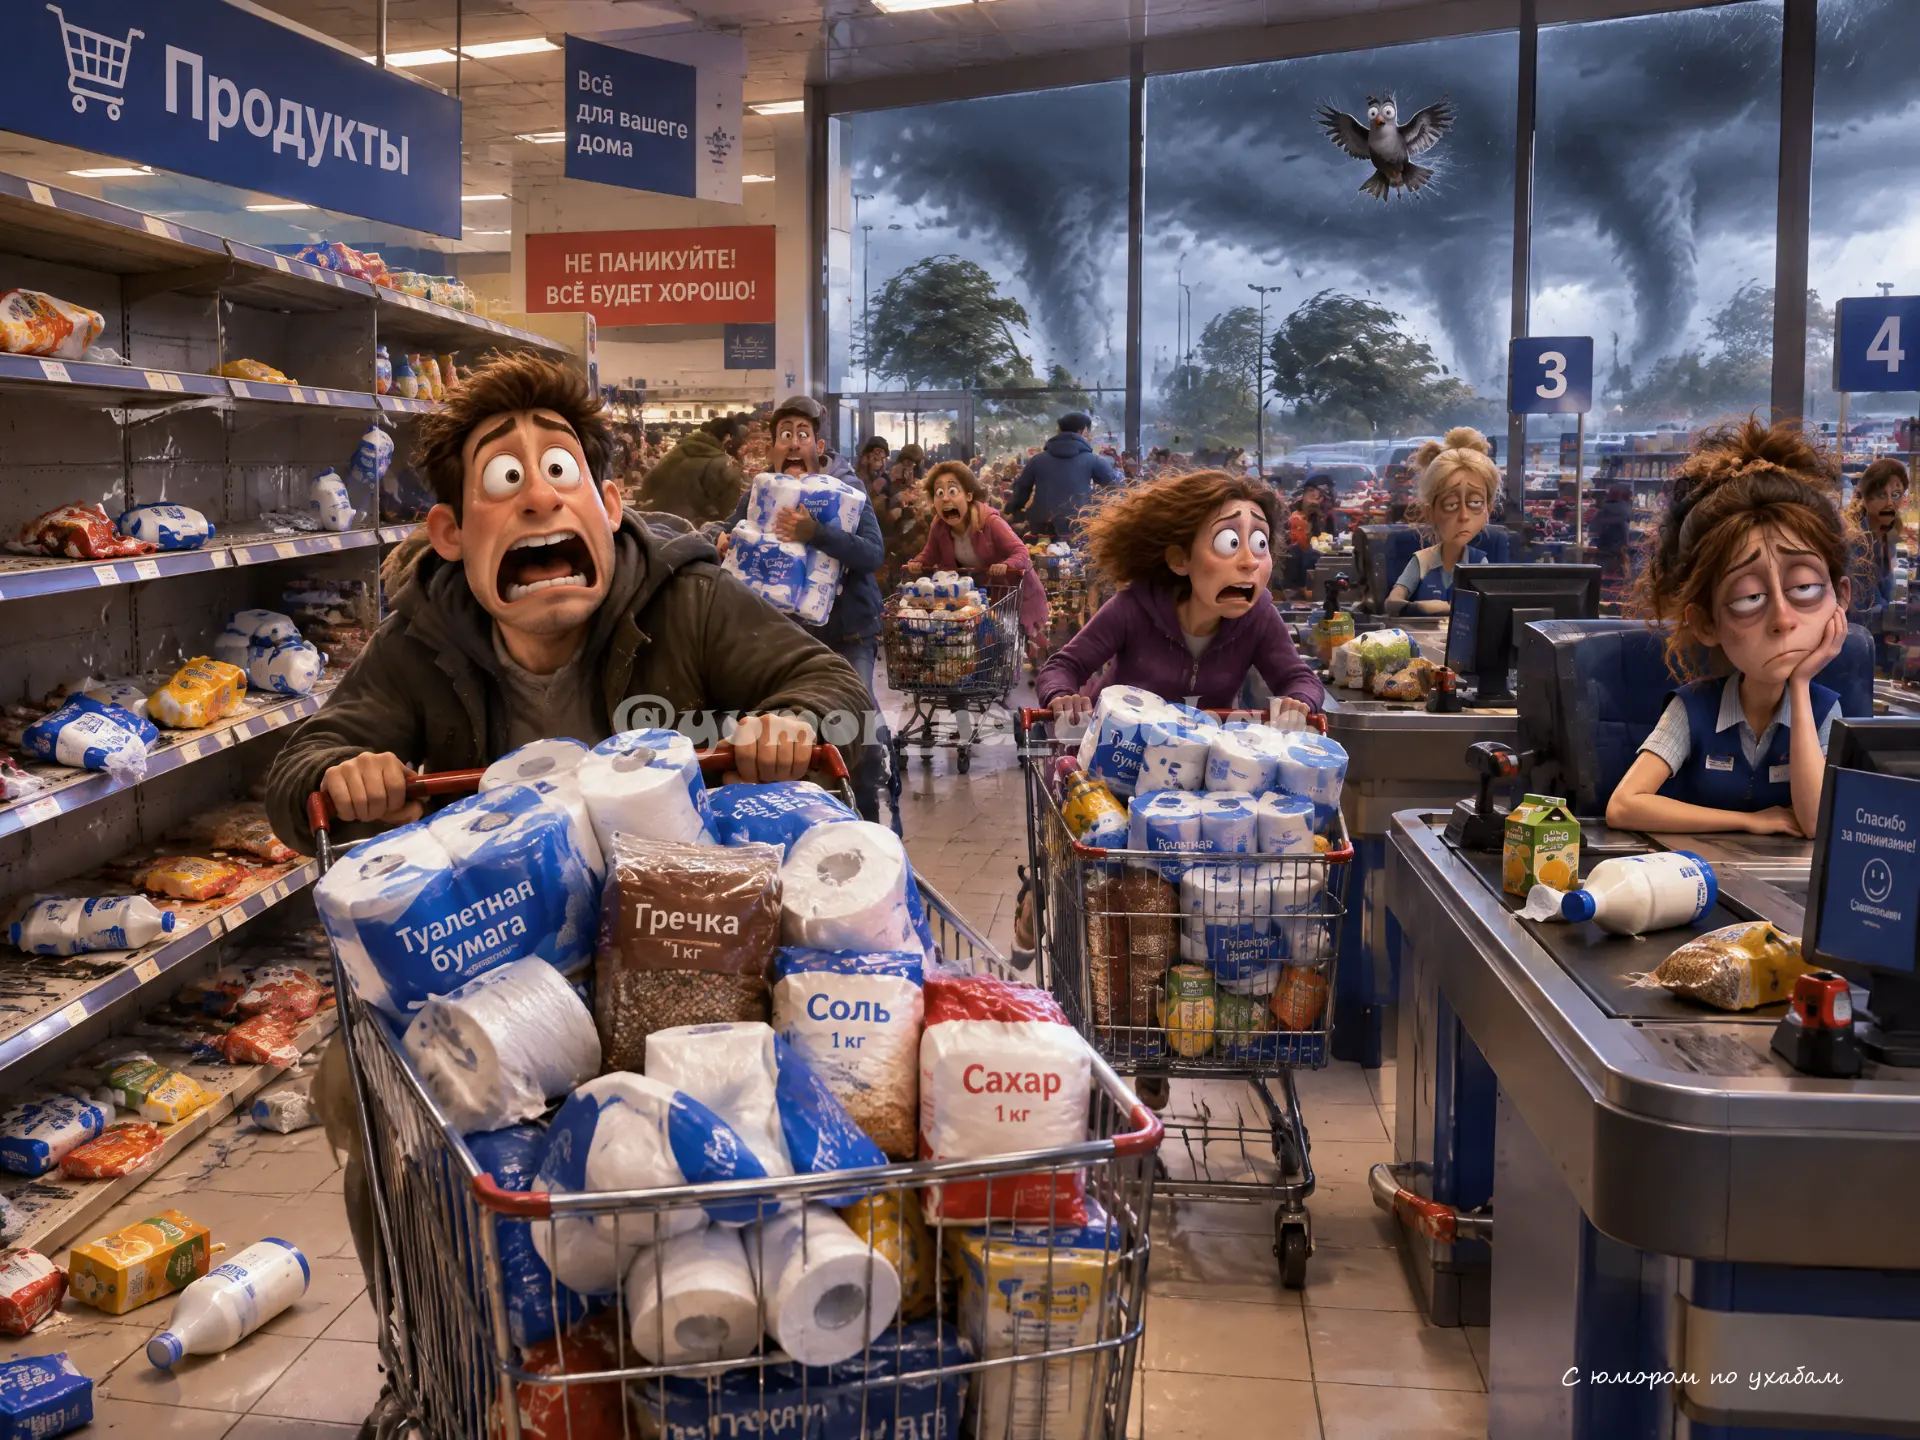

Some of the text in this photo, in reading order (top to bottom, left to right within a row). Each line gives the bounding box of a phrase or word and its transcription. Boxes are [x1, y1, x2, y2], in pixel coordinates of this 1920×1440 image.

[578, 70, 613, 97] Всё
[165, 44, 409, 176] Продукты
[576, 103, 614, 125] для
[577, 133, 633, 158] дома
[565, 245, 736, 273] НЕ ПАНИКУЙТЕ!
[546, 280, 756, 307] ВСЁ БУДЕТ ХОРОШО!
[1866, 316, 1905, 373] 4
[1535, 351, 1568, 399] 3
[1855, 807, 1906, 833] Спасибо
[1841, 829, 1853, 841] за
[395, 880, 535, 955] Туалетная
[635, 903, 739, 935] Гречка
[430, 915, 528, 972] бумага
[683, 946, 702, 960] кг
[807, 993, 891, 1023] Соль
[831, 1031, 866, 1049] 1 кг
[963, 1063, 1062, 1101] Сахар
[995, 1104, 1031, 1122] 1 кг
